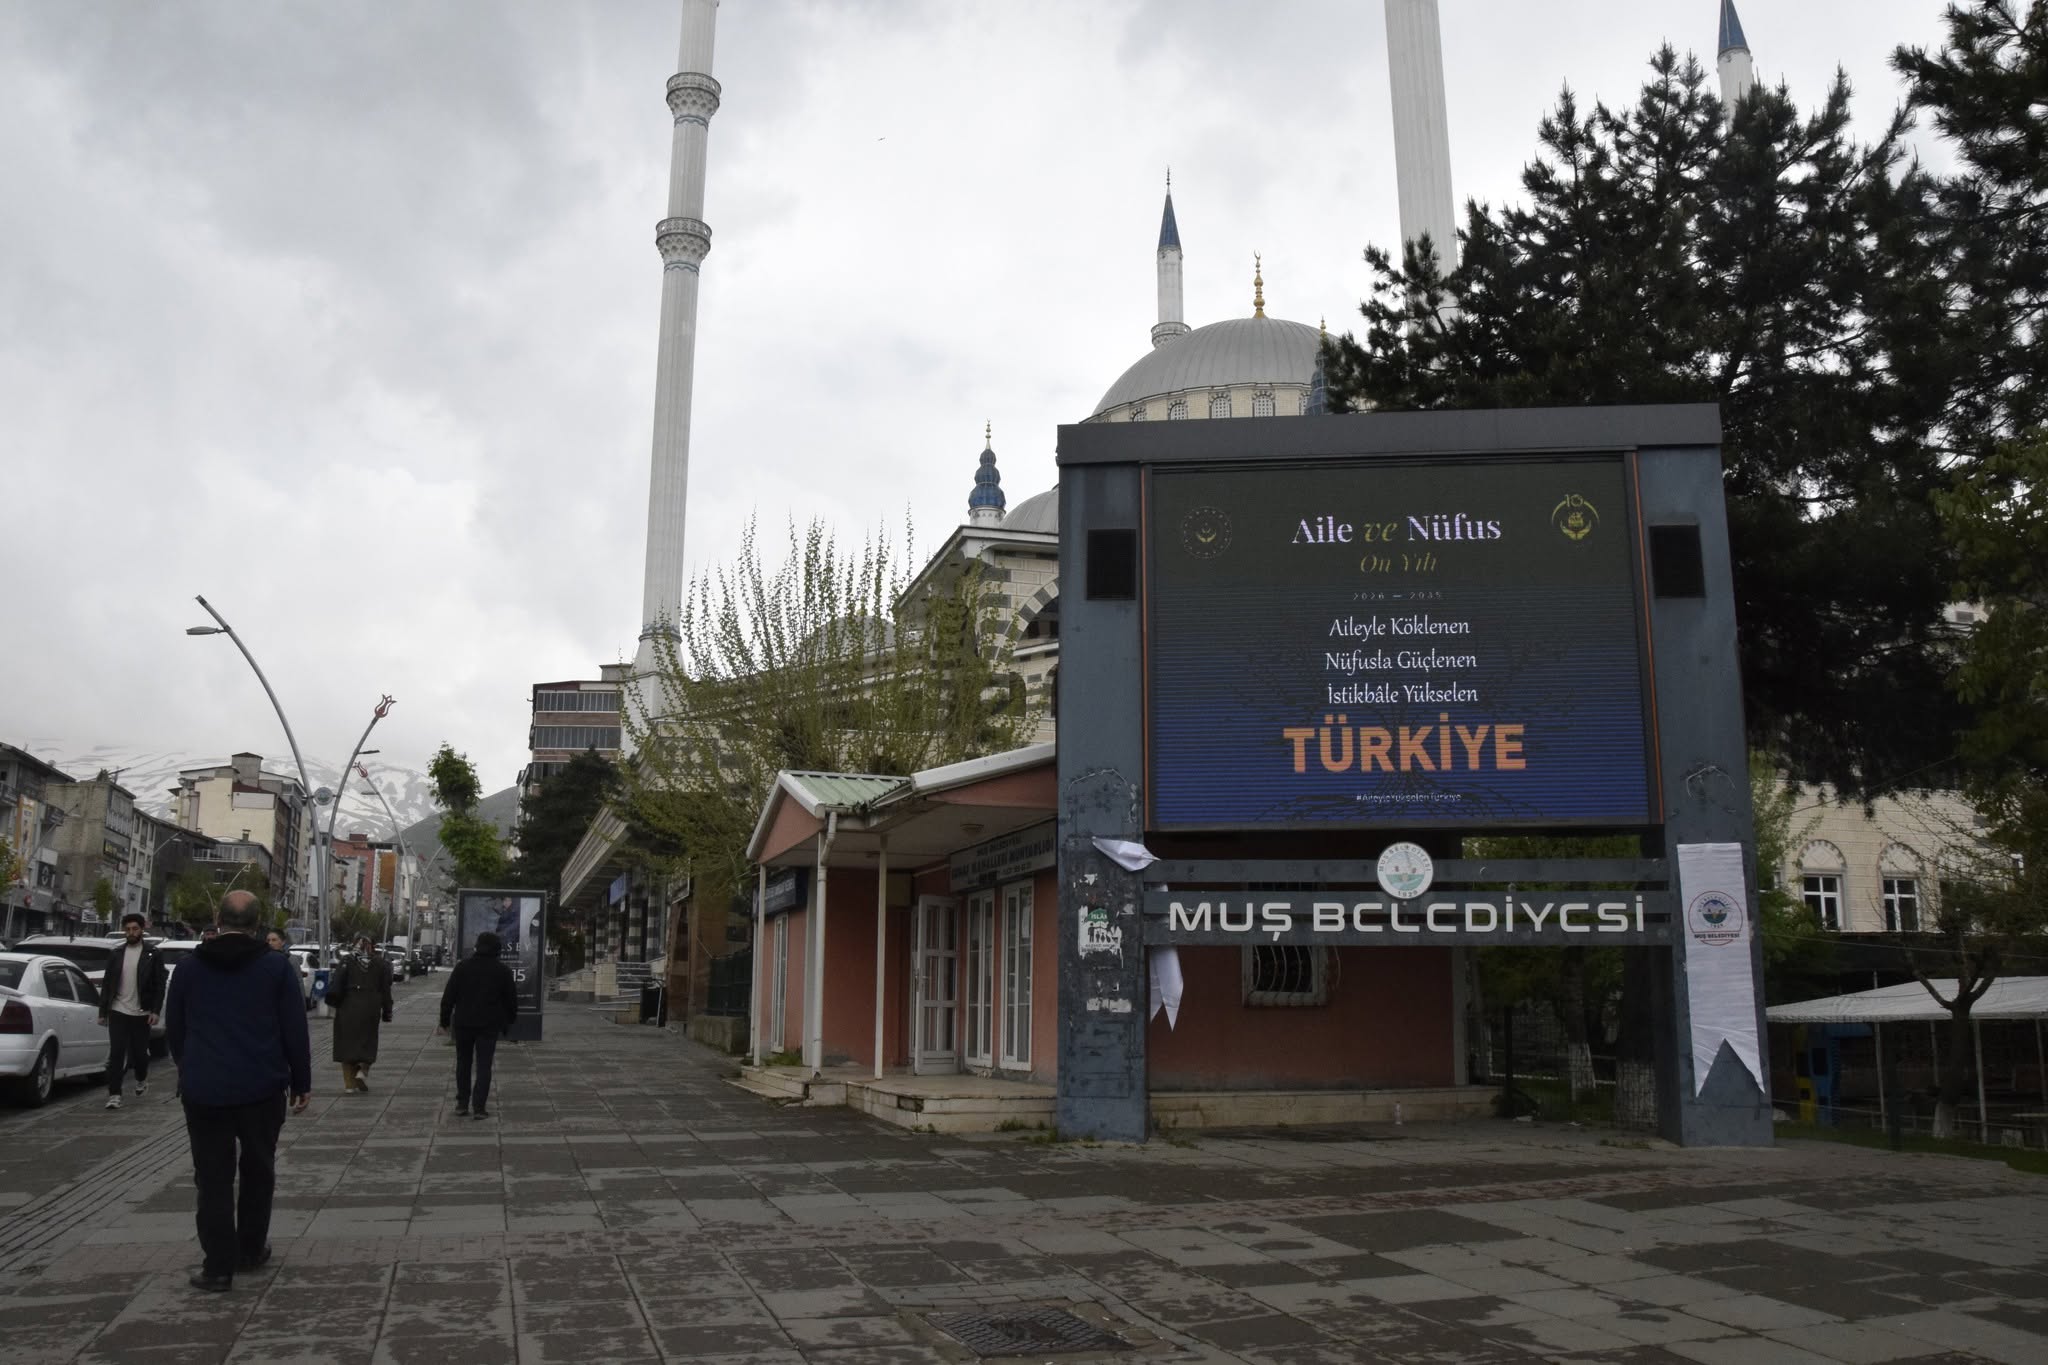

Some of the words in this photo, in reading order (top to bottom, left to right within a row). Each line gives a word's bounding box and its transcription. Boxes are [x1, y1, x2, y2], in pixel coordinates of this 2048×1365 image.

[1291, 516, 1353, 544] Aile
[1363, 522, 1399, 543] ve
[1406, 512, 1502, 541] Nüfus
[1360, 553, 1391, 573] On
[1329, 615, 1386, 642] Aileyle
[1390, 614, 1471, 635] Köklenen
[1325, 649, 1393, 676] Nüfusla
[1397, 647, 1477, 673] Güçlenen
[1328, 682, 1399, 704] İstikbâle
[1403, 681, 1479, 703] Yükselen
[1283, 712, 1527, 774] TÜRKİYE
[1169, 901, 1293, 942] MUŞ
